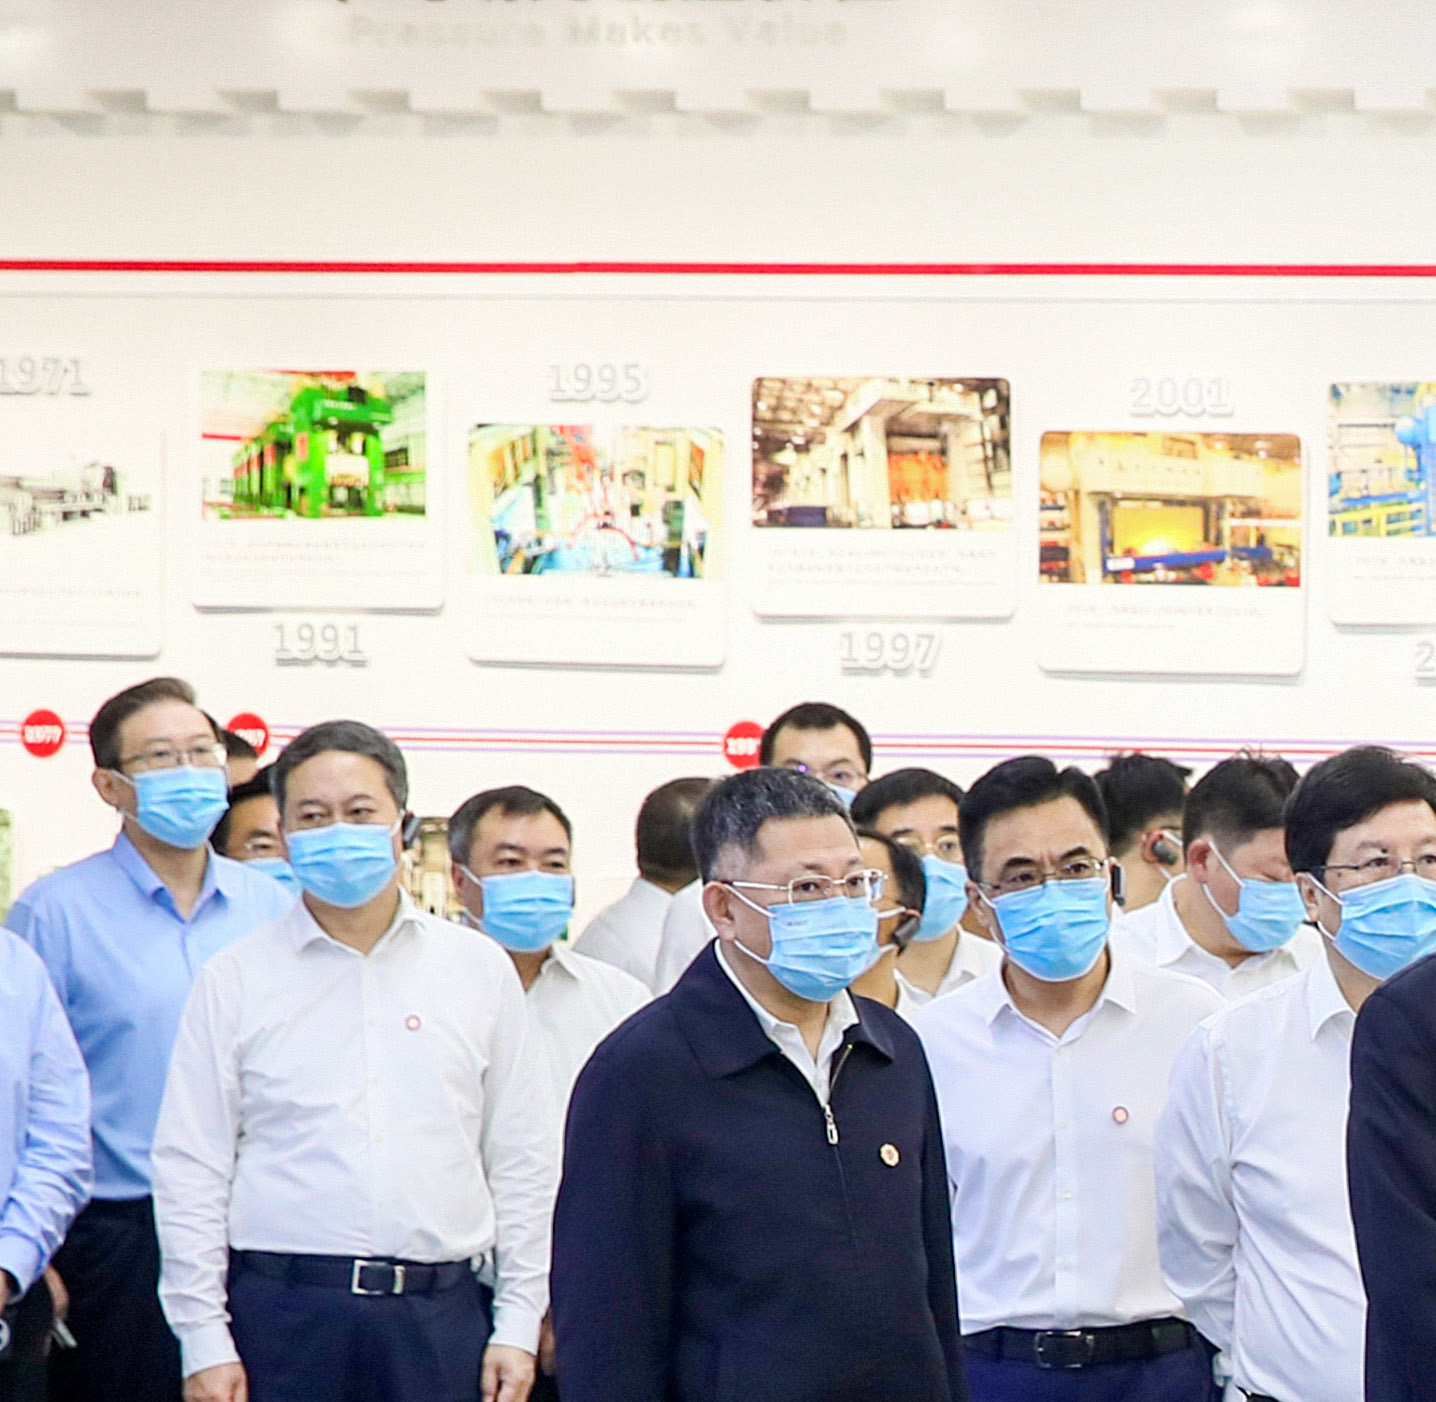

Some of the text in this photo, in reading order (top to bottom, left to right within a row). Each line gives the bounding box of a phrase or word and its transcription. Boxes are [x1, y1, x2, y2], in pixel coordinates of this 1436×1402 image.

[0, 356, 90, 395] 1971
[548, 362, 645, 400] 1995
[1129, 376, 1232, 415] 2001
[273, 623, 366, 662] 1991
[838, 631, 939, 671] 1997
